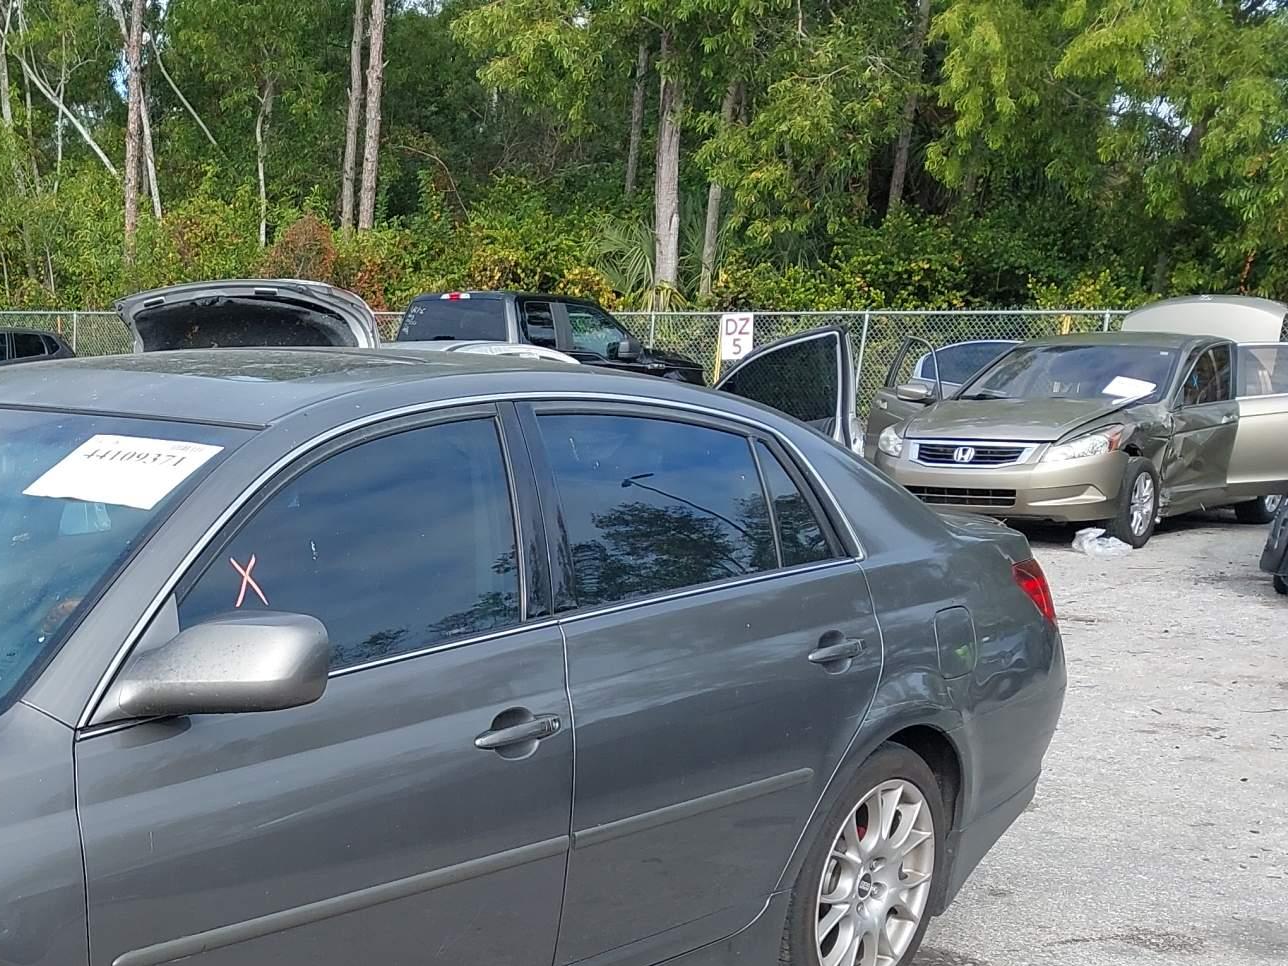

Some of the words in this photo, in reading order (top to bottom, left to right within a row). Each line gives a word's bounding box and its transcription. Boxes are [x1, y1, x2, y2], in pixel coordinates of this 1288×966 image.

[725, 317, 751, 336] DZ
[732, 338, 742, 355] 5
[83, 448, 187, 467] 44109371
